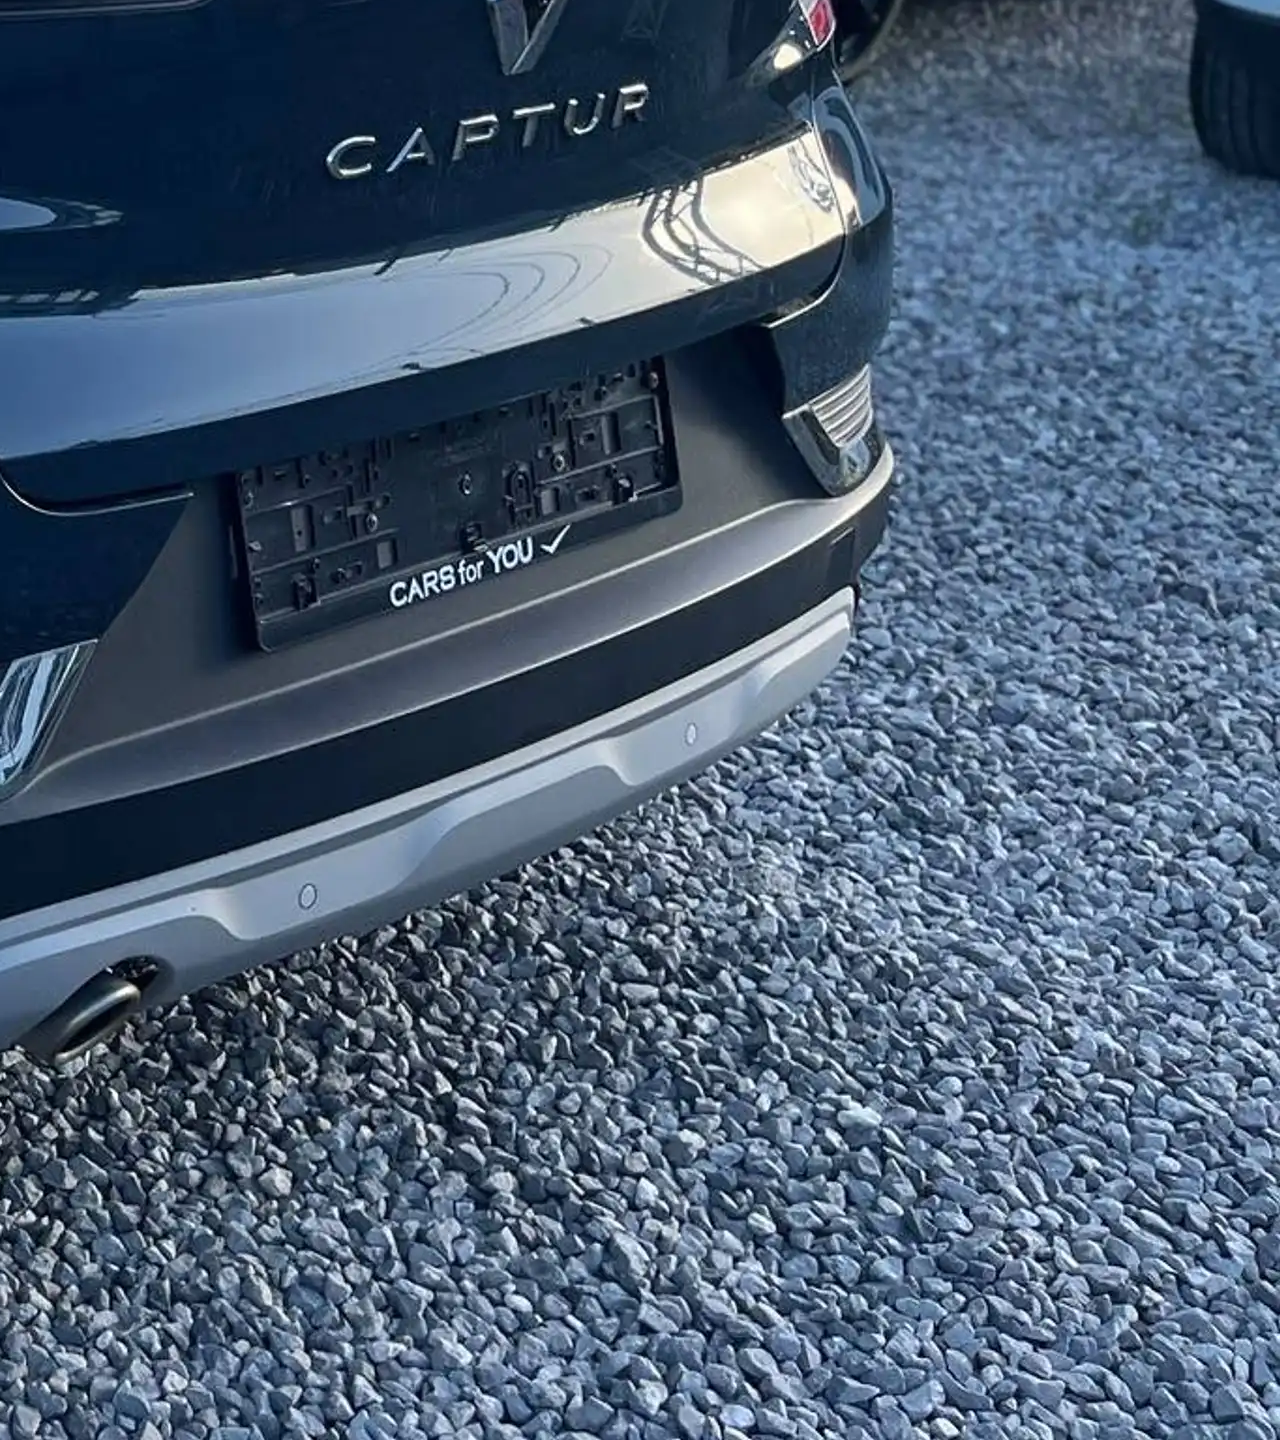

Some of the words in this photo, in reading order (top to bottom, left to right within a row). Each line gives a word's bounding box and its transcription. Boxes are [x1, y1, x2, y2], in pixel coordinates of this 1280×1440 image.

[326, 82, 650, 180] CAPTUR
[389, 564, 457, 608] CARS
[457, 559, 485, 586] for
[486, 535, 534, 574] YOU
